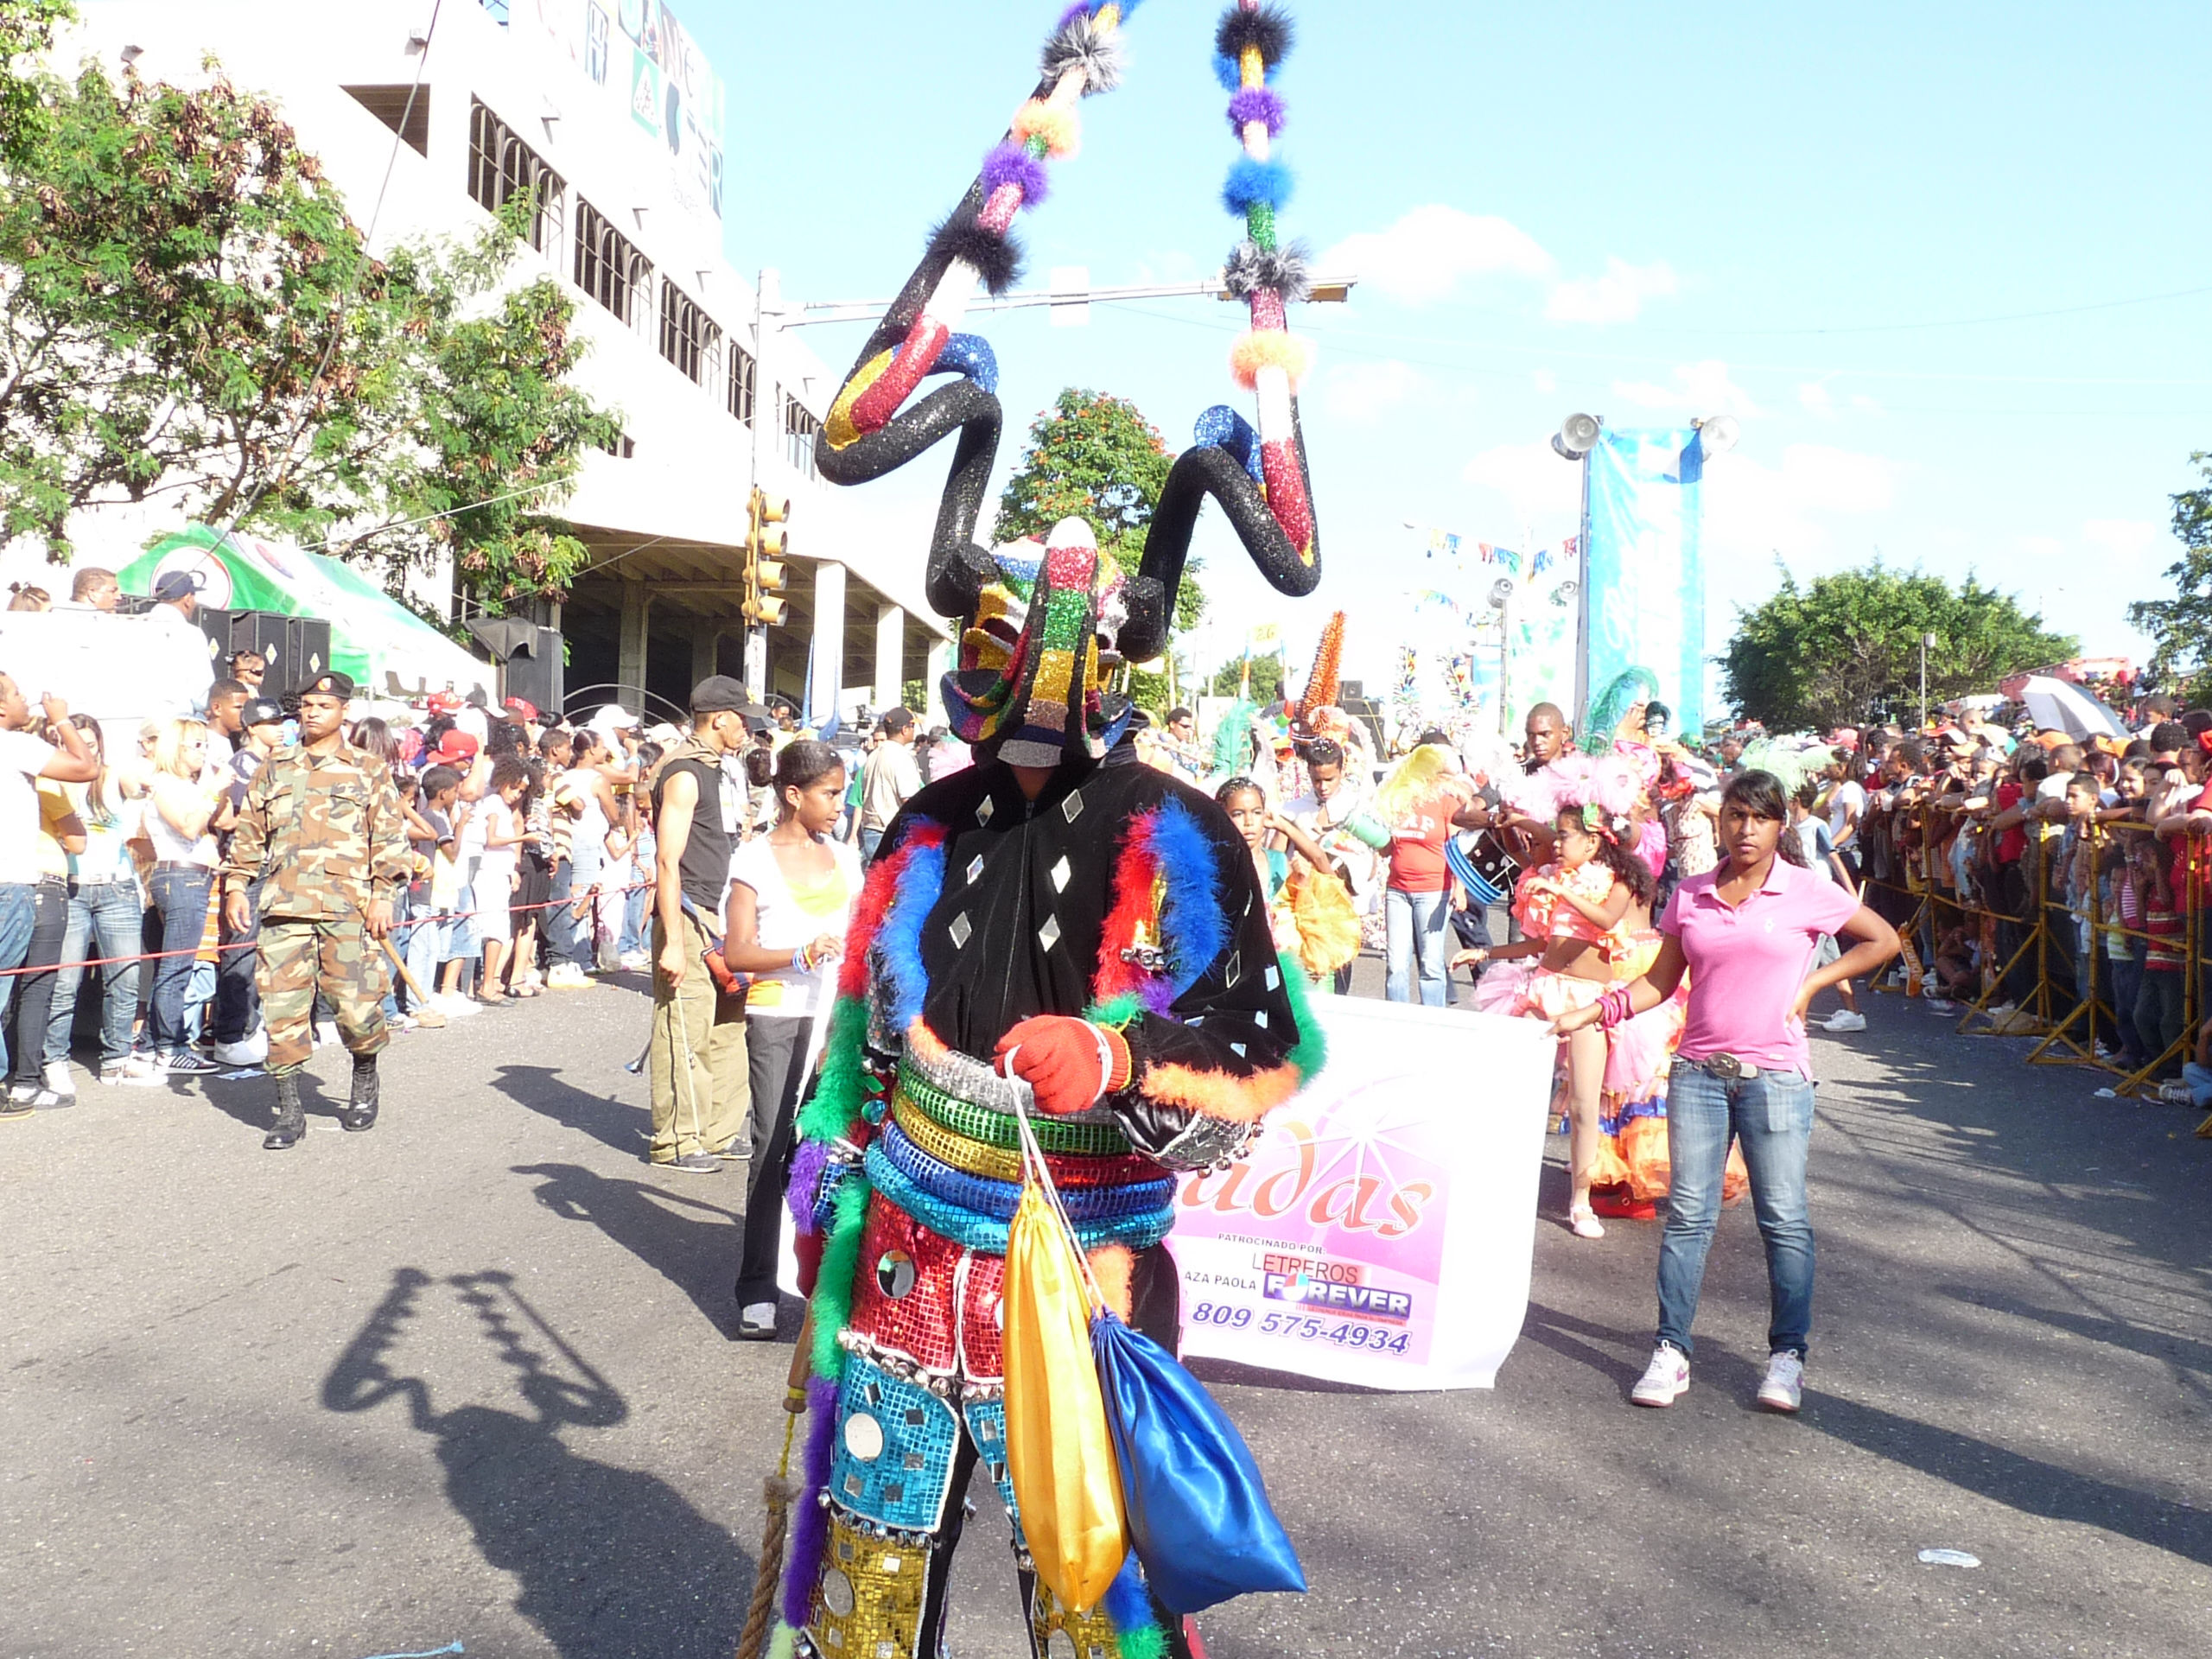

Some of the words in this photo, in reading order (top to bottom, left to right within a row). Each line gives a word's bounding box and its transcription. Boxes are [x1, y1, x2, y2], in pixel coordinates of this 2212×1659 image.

[1218, 1233, 1295, 1250] PATROCINADO
[1300, 1244, 1327, 1255] POR:
[1214, 1274, 1256, 1291] PAOLA
[1252, 1253, 1358, 1285] LETREROS
[1267, 1274, 1410, 1317] FOREVER
[1192, 1302, 1252, 1327] 809
[1260, 1312, 1412, 1354] 575-4934
